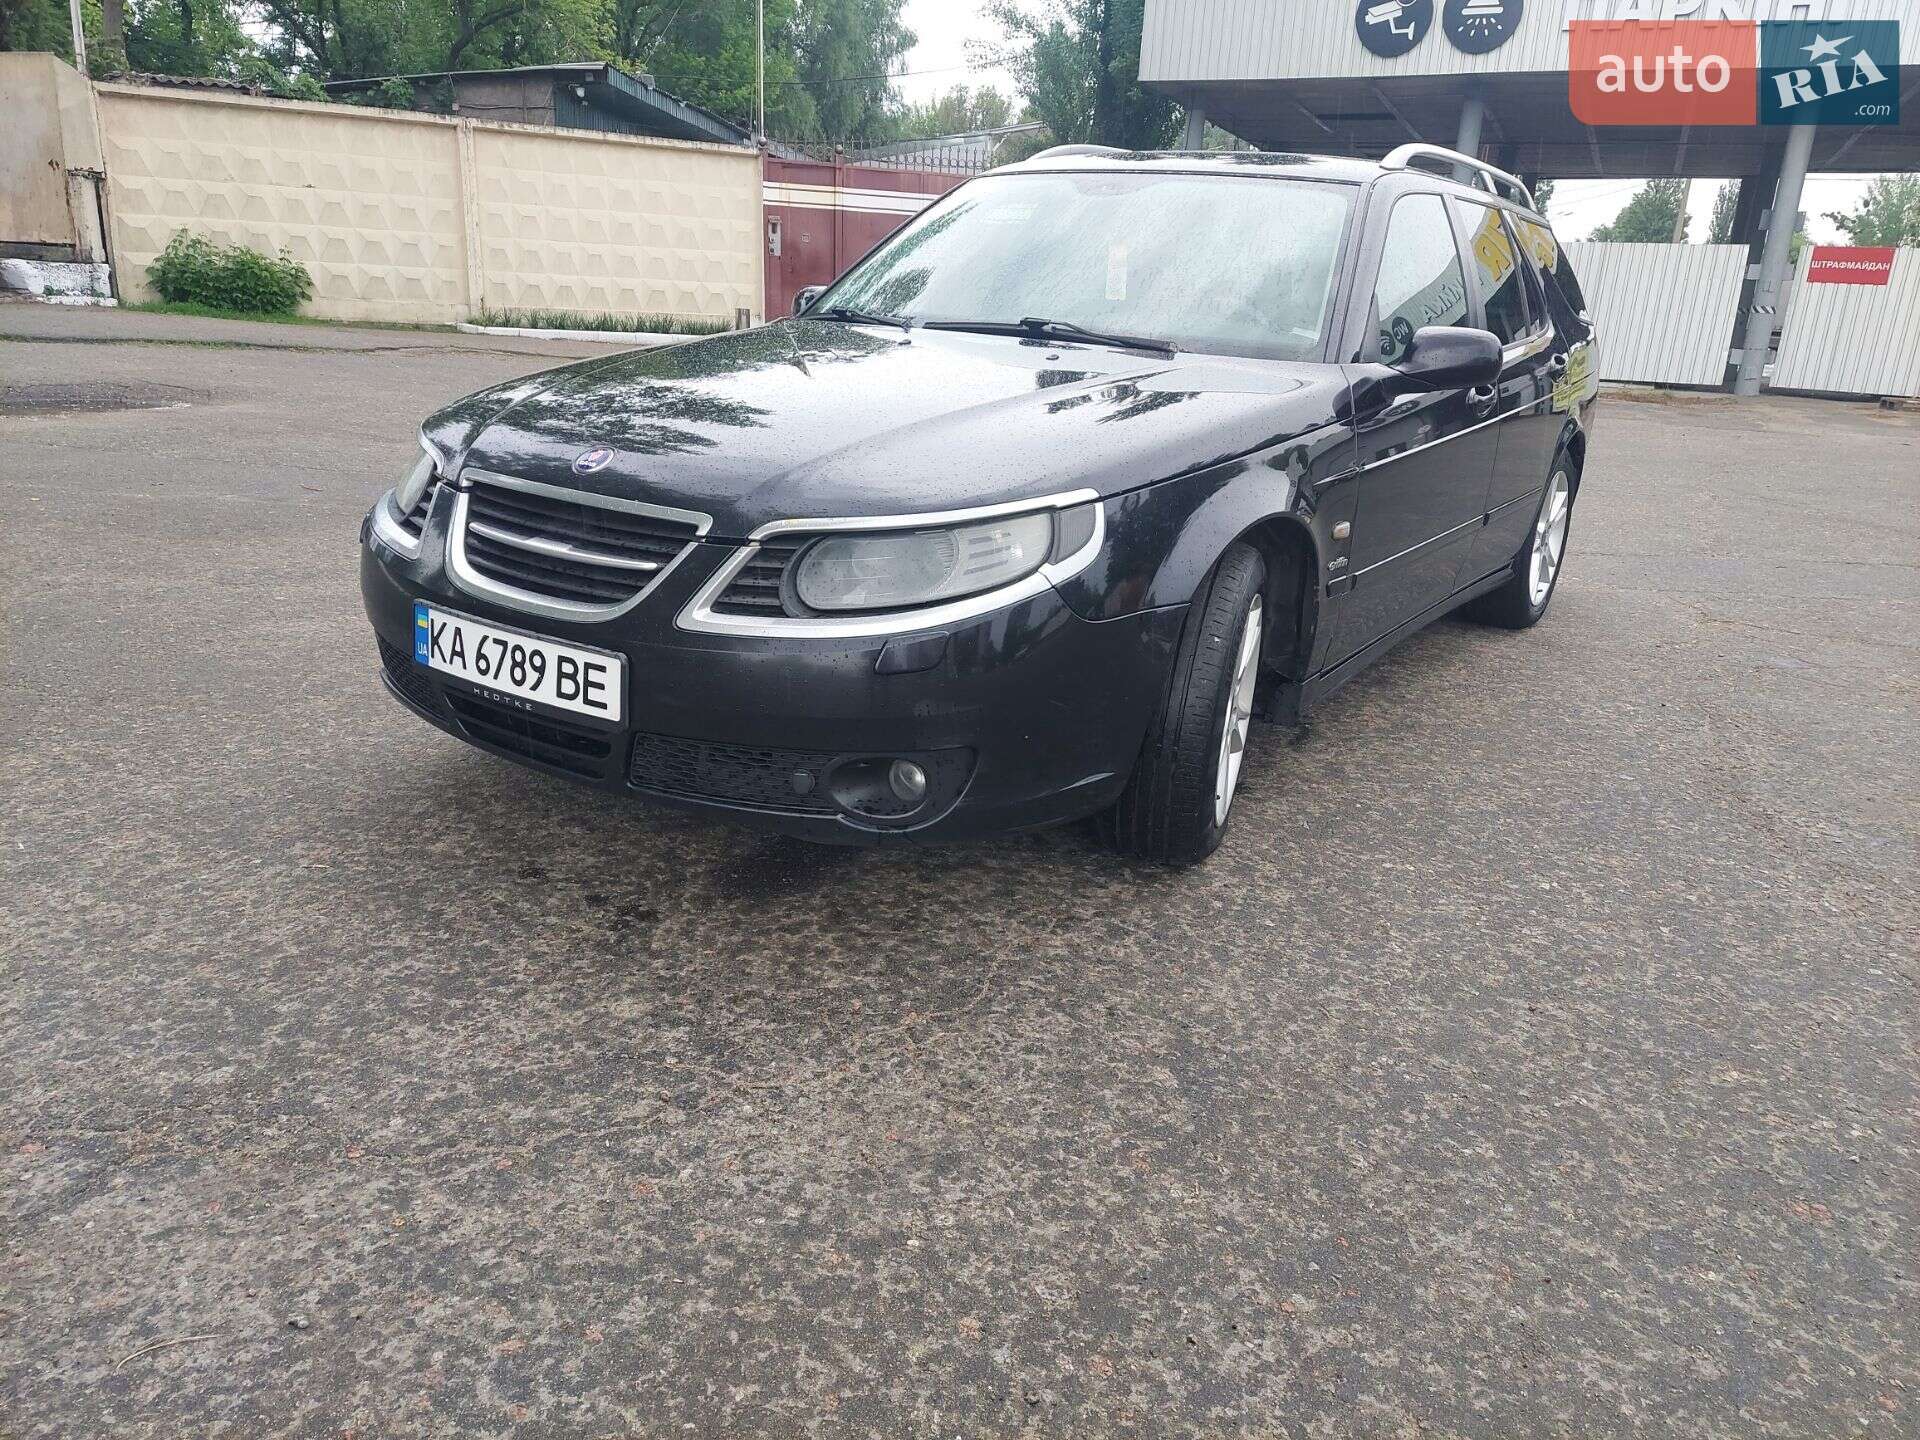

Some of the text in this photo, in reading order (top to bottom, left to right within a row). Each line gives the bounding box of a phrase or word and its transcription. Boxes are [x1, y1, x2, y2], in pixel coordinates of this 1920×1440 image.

[1811, 260, 1891, 272] ШТРАФМАЙДАН
[417, 642, 428, 656] UA
[430, 618, 608, 710] KA 6789 BE
